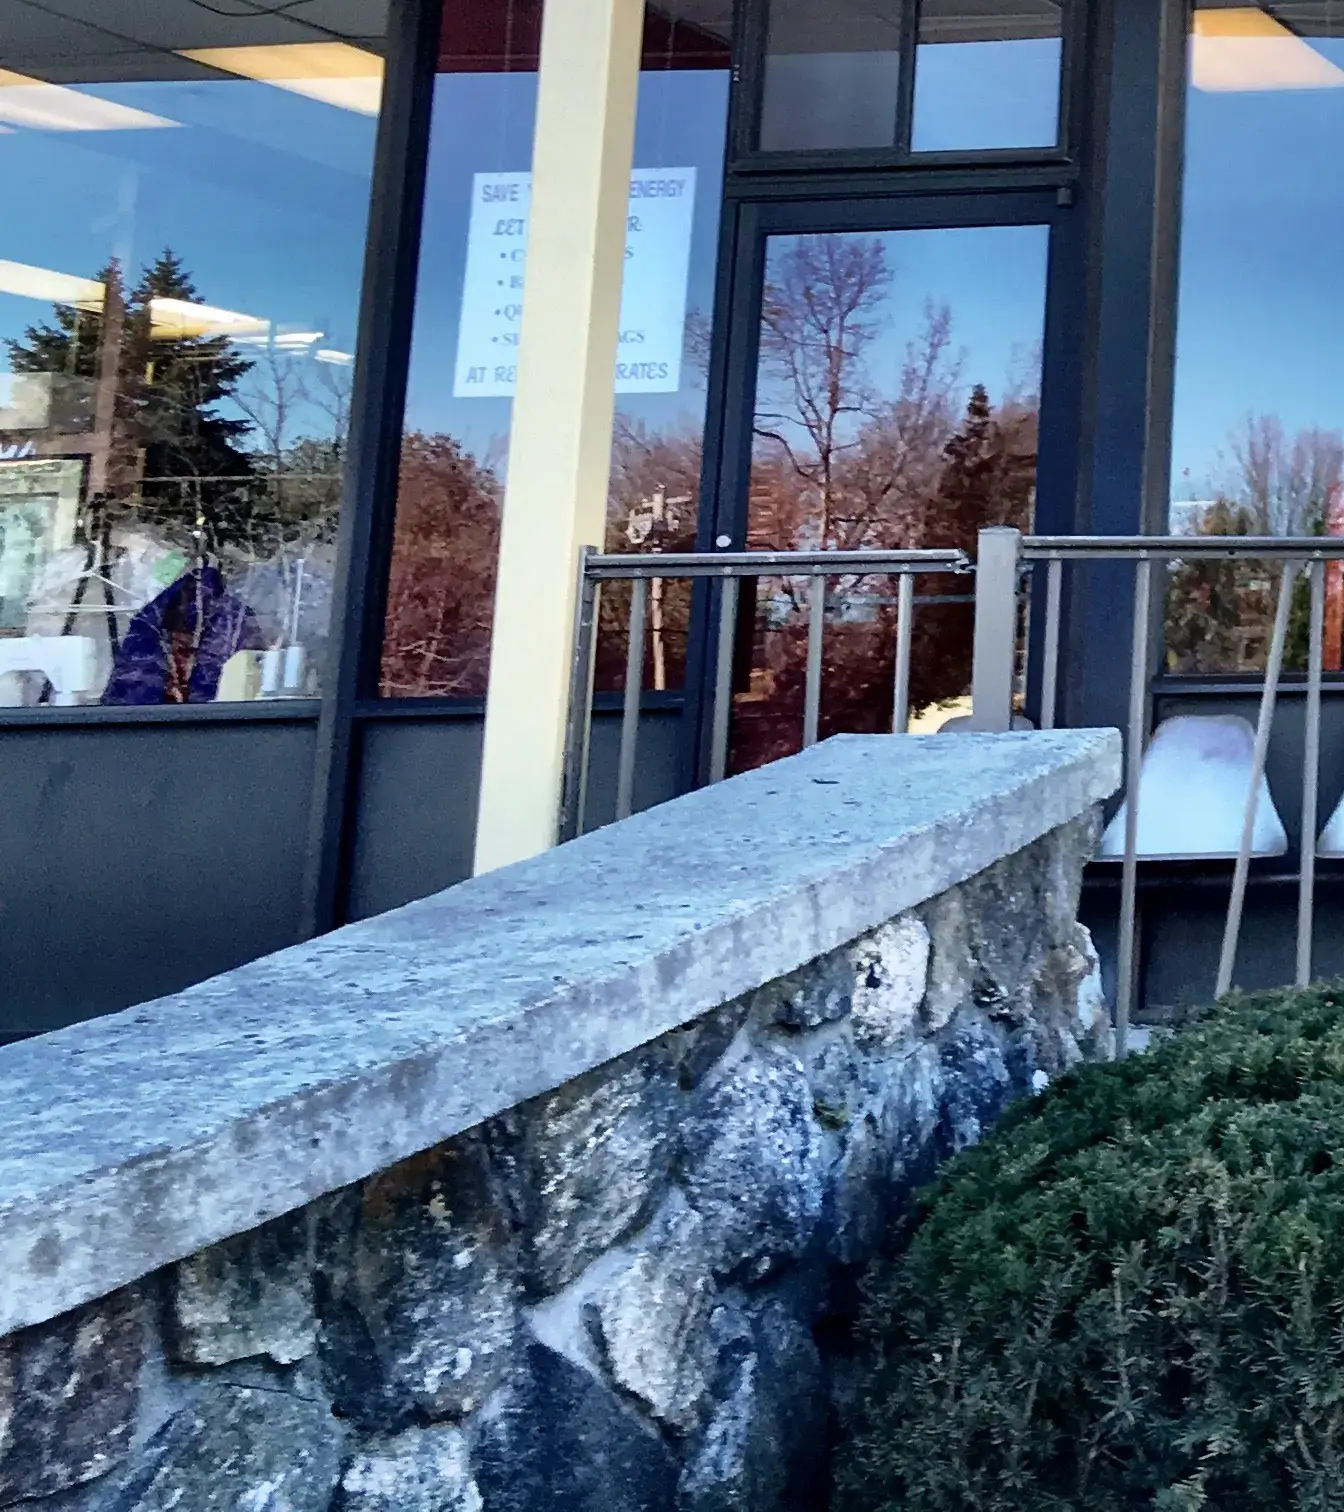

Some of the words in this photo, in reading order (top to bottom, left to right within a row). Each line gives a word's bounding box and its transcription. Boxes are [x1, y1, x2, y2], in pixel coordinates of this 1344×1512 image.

[481, 183, 520, 204] SAVE
[629, 178, 687, 199] ENERGY
[465, 365, 488, 384] AT
[615, 362, 669, 381] RATES
